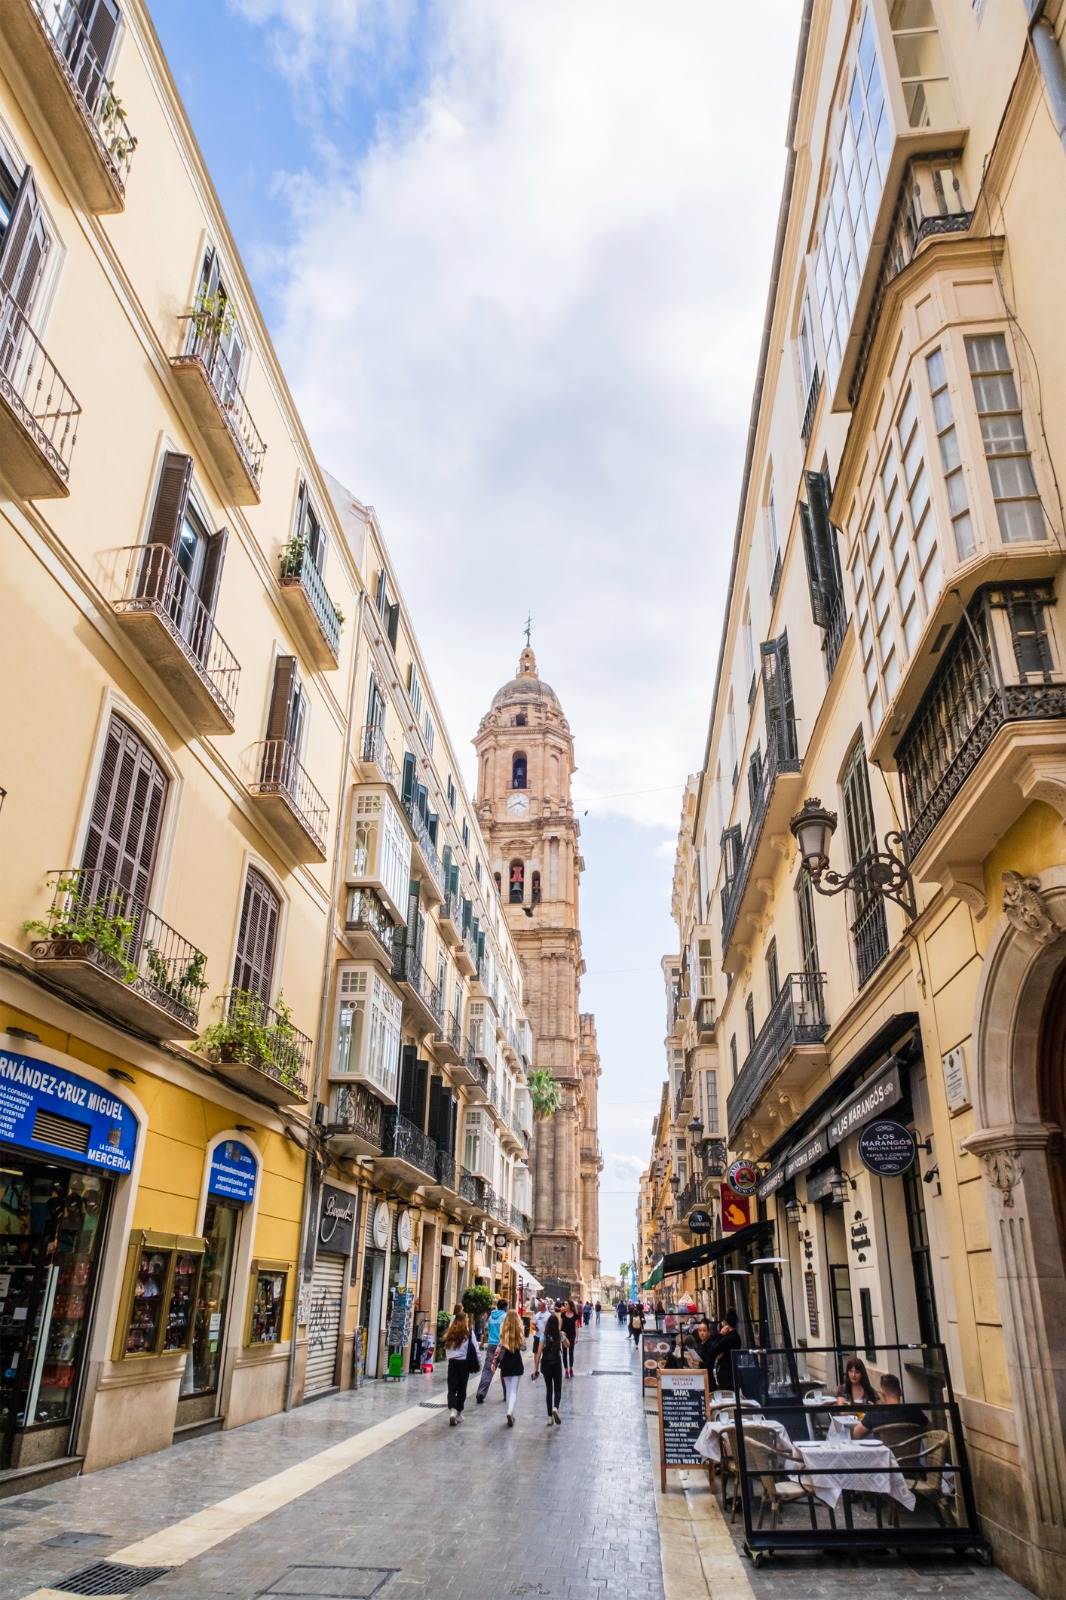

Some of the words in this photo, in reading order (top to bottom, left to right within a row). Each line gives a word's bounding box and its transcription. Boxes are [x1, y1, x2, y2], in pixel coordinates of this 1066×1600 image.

[87, 1092, 123, 1121] MIGUEL
[848, 1085, 885, 1126] MARANGÓS
[3, 1108, 25, 1120] EVENTOS
[862, 1138, 912, 1147] MARANGÓS
[105, 1145, 124, 1156] CATEDRAL
[87, 1149, 131, 1171] MERCERÍA
[730, 1161, 759, 1177] PAULANER
[673, 1389, 690, 1398] TAPAS
